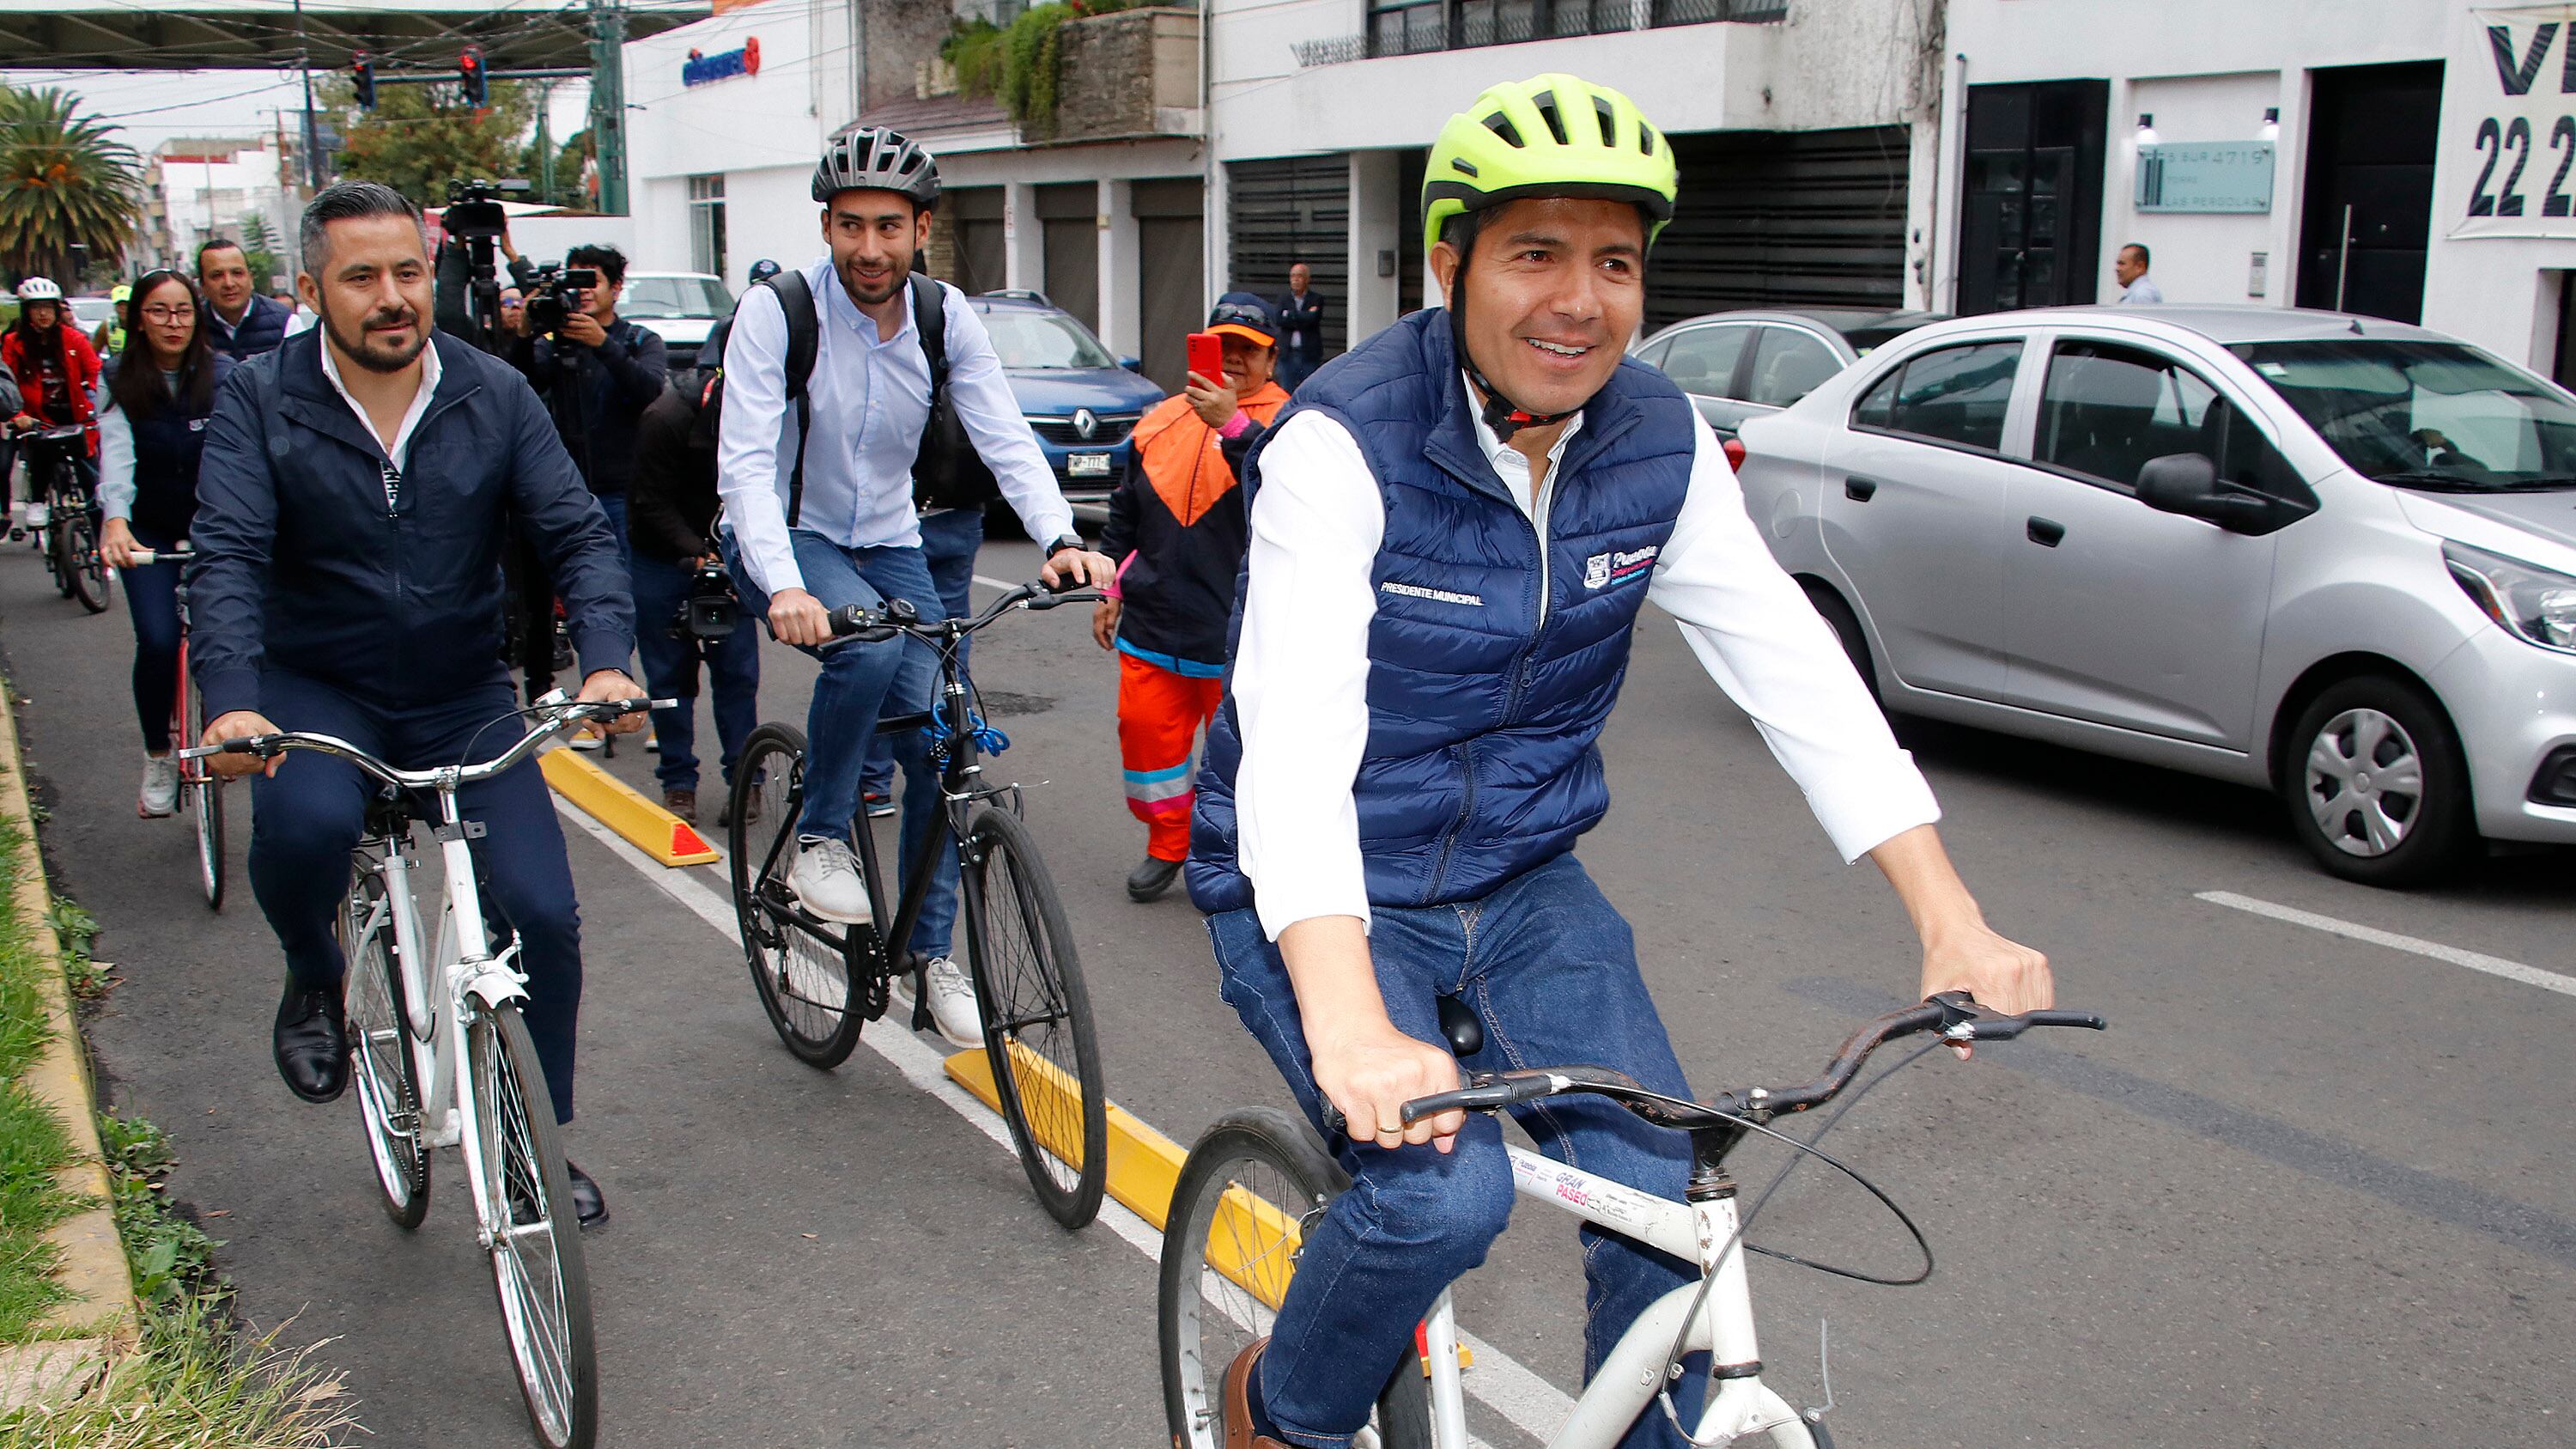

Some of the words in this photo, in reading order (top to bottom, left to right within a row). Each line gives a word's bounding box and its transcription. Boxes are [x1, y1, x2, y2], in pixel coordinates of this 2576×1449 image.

[2487, 21, 2576, 95] V
[2467, 116, 2530, 216] 22
[2541, 114, 2576, 216] 2
[1380, 581, 1433, 600] PRESIDENTE
[1432, 589, 1485, 606] MUNICIPAL
[1555, 1172, 1588, 1190] GRAN
[1555, 1183, 1589, 1207] PASEO
